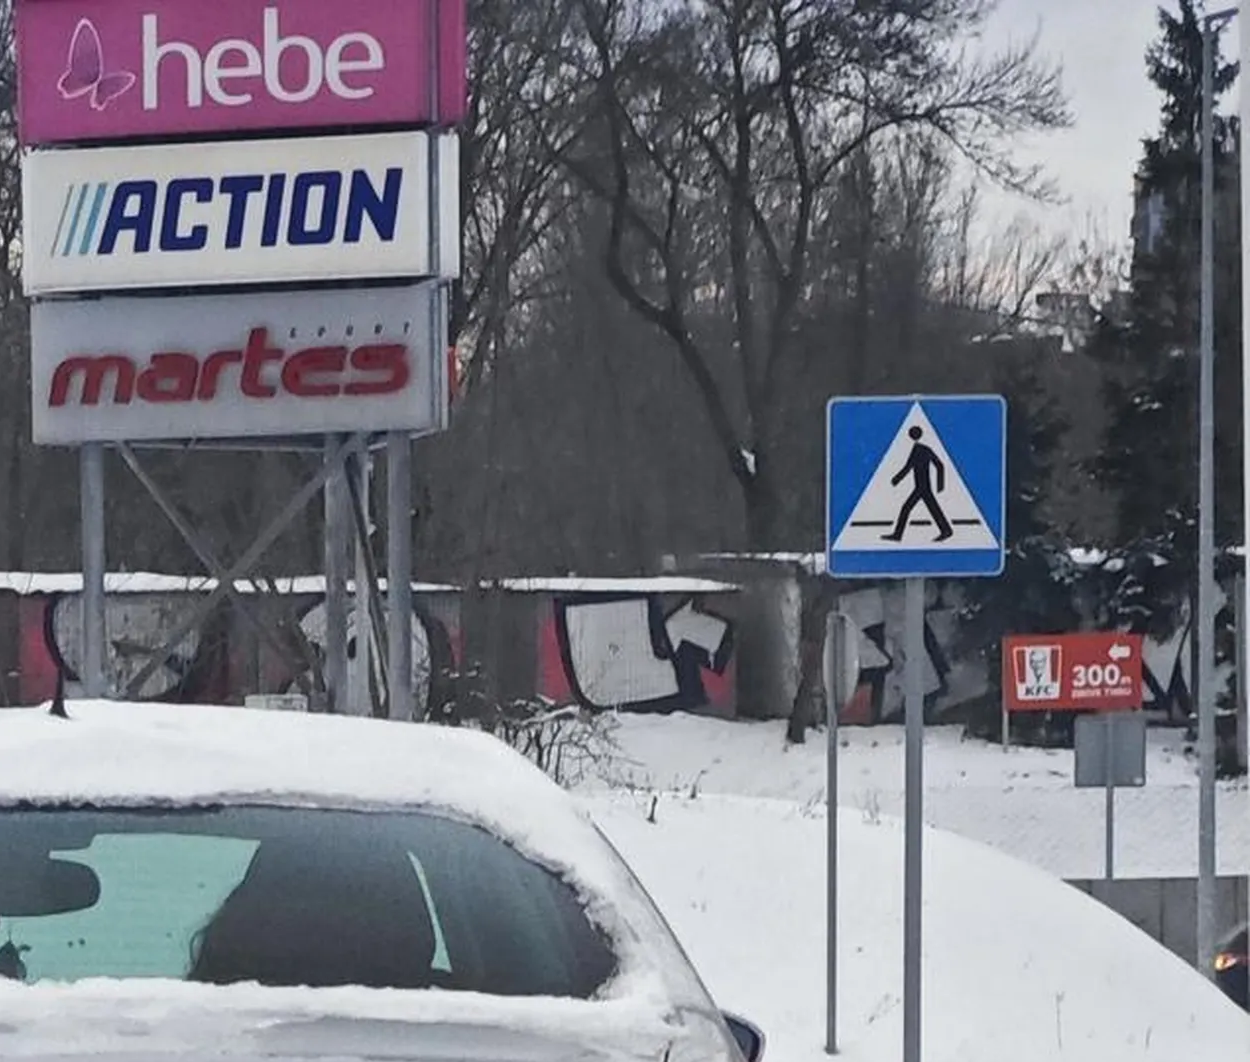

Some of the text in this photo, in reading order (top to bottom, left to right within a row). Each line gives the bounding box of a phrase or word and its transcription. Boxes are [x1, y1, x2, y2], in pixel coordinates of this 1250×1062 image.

[142, 6, 385, 110] hebe
[96, 167, 404, 255] ACTION
[48, 326, 410, 407] martes
[1024, 685, 1055, 697] KFC
